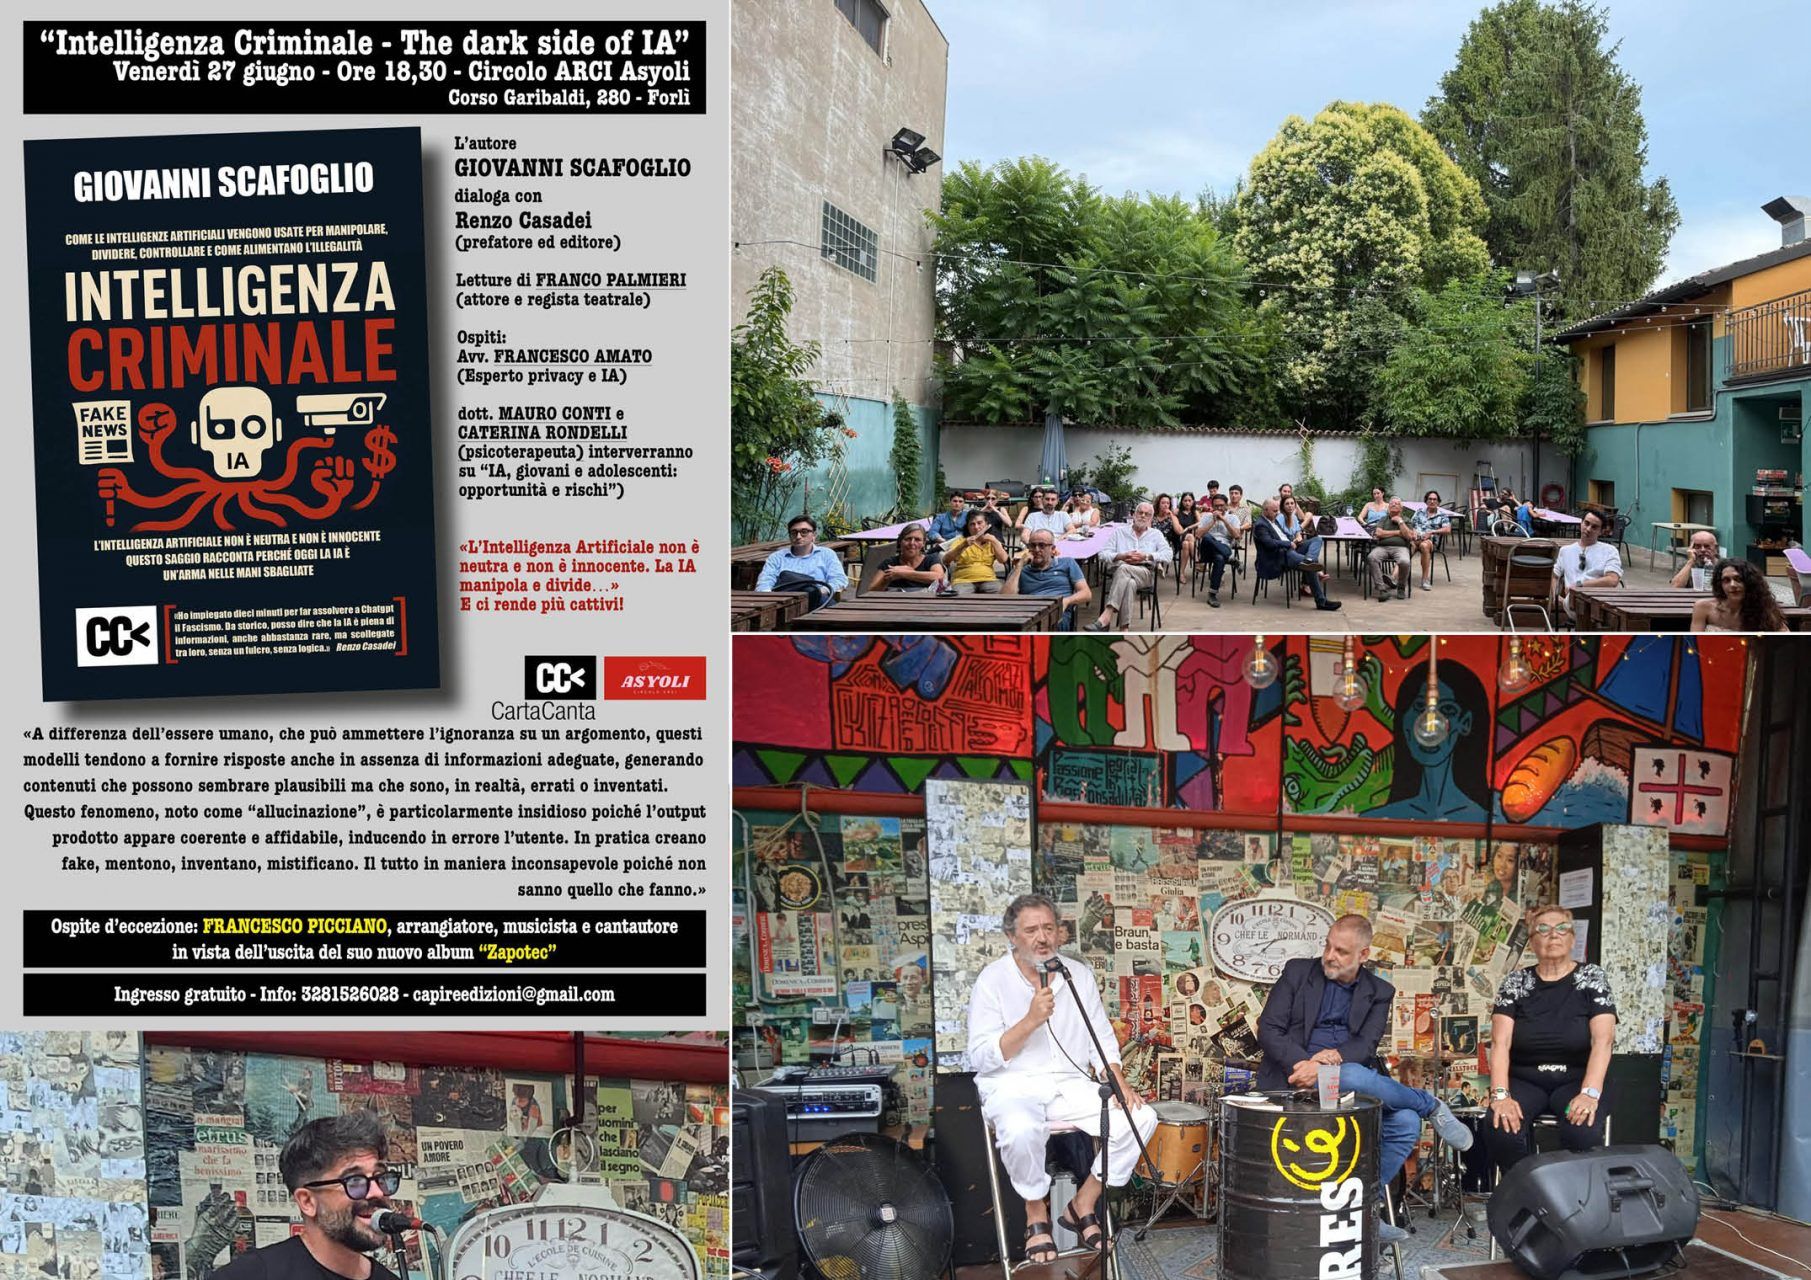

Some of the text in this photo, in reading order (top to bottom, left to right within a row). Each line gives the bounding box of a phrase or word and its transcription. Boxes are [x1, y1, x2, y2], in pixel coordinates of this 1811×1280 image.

[40, 28, 689, 60] “Intelligenza Criminale The dark side of IA”
[112, 59, 691, 87] Venerdì 27 giugno Ore 18,30 Circolo ARCI Asyoli
[448, 87, 691, 109] Corso Garibaldi, 280 Forlì
[454, 135, 517, 150] L’autore
[454, 157, 691, 177] GIOVANNI SCAFOGLIO
[73, 161, 374, 203] GIOVANNI SCAFOGLIO
[454, 187, 543, 207] dialoga con
[455, 210, 593, 229] Renzo Casadei
[66, 224, 388, 245] COME LE INTELLIGENZE ARTIFICIALI VENGONO USATE PER MANIPOLARE,
[455, 234, 621, 253] (prefatore ed editore)
[92, 239, 362, 260] DIVIDERE, CONTROLLARE E COME ALIMENTANO L’ILLEGALITÀ
[455, 272, 687, 287] Letture di FRANCO PALMIERI
[65, 261, 396, 322] INTELLIGENZA
[68, 318, 397, 392] CRIMINALE
[457, 367, 627, 386] (Esperto privacy e IA)
[80, 406, 127, 423] FAKE
[82, 423, 128, 438] NEWS
[227, 452, 250, 470] IA
[620, 675, 691, 688] ASYOLI
[491, 700, 596, 721] CartaCanta
[517, 882, 706, 900] sanno quello che fanno.»
[1160, 887, 1184, 897] Giulia
[51, 917, 679, 938] Ospite d’eccezione: FRANCESCO PICCIANO, arrangiatore, musicista e cantautore
[1115, 926, 1151, 938] Braun,
[1234, 929, 1318, 941] CHEF LE NORMAND
[1115, 939, 1160, 950] e basta
[114, 985, 616, 1006] Ingresso gratuito Info: 3281526028 capireedizioni@gmail.com
[333, 1058, 345, 1092] BUTON
[598, 1105, 617, 1118] per
[599, 1117, 634, 1129] uomini
[421, 1140, 464, 1152] UN POVERO
[599, 1131, 617, 1143] che
[203, 1156, 216, 1165] che
[423, 1151, 451, 1163] AMORE
[600, 1147, 639, 1159] lasciano
[600, 1161, 640, 1175] il segno
[526, 1218, 547, 1241] 11
[558, 1217, 587, 1242] 12
[600, 1223, 608, 1246] 1
[485, 1234, 511, 1259] 10
[633, 1239, 653, 1263] 2
[567, 1244, 580, 1254] DE
[582, 1246, 618, 1273] CUISINE
